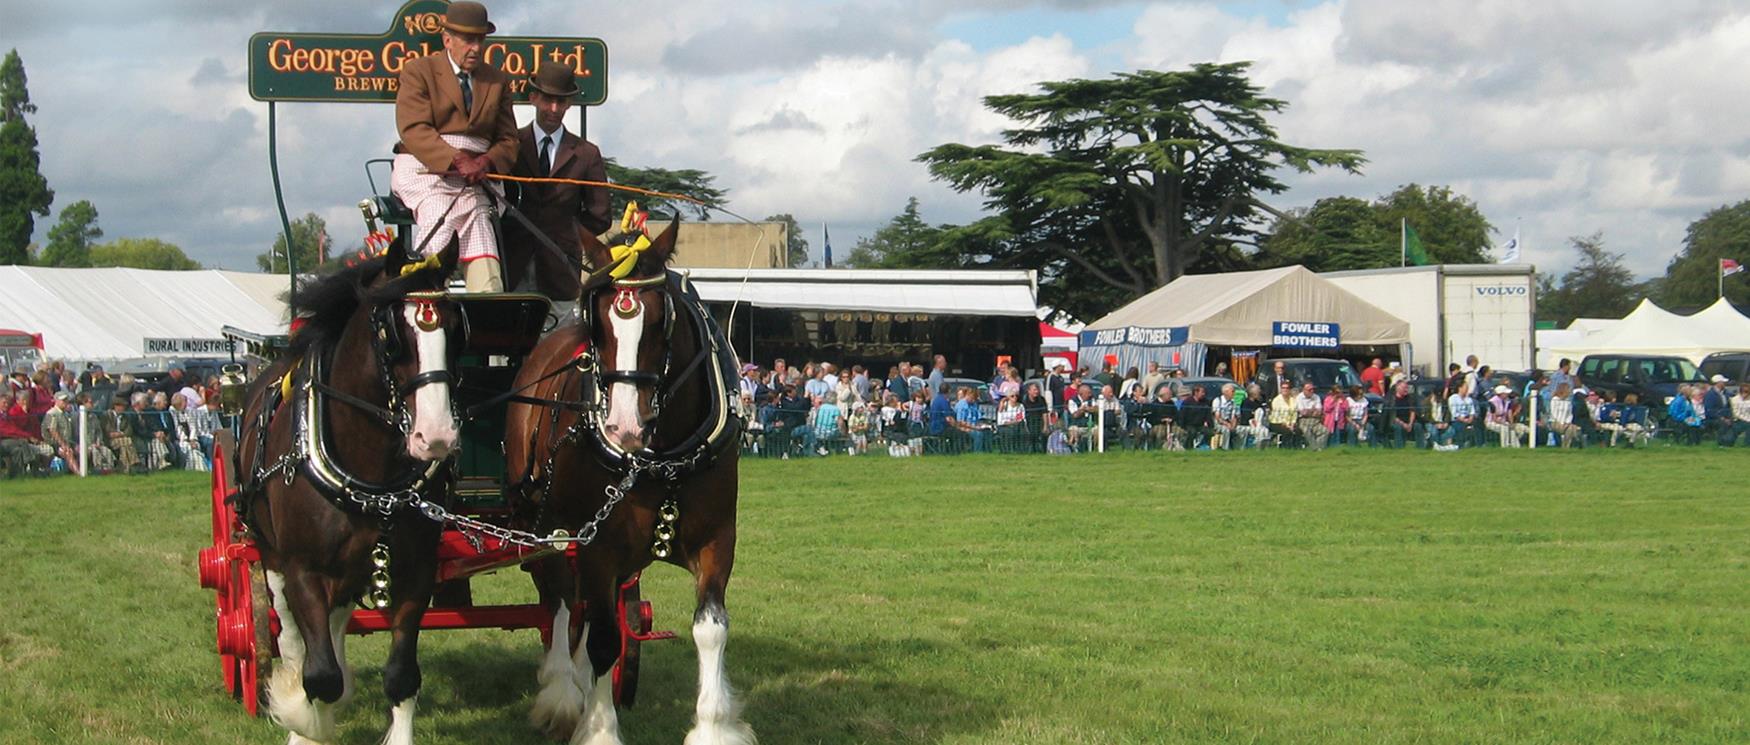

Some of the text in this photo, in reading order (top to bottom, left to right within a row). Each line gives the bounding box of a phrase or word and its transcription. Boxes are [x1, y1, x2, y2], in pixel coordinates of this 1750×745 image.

[268, 38, 375, 76] George
[334, 77, 398, 92] BREWE
[1476, 286, 1526, 296] VOLVO
[1281, 322, 1330, 334] FOWLER
[1094, 326, 1172, 346] FOWLER BROTHERS
[1273, 335, 1338, 348] BROTHERS
[148, 340, 237, 353] RURAL INDUSTRIES
